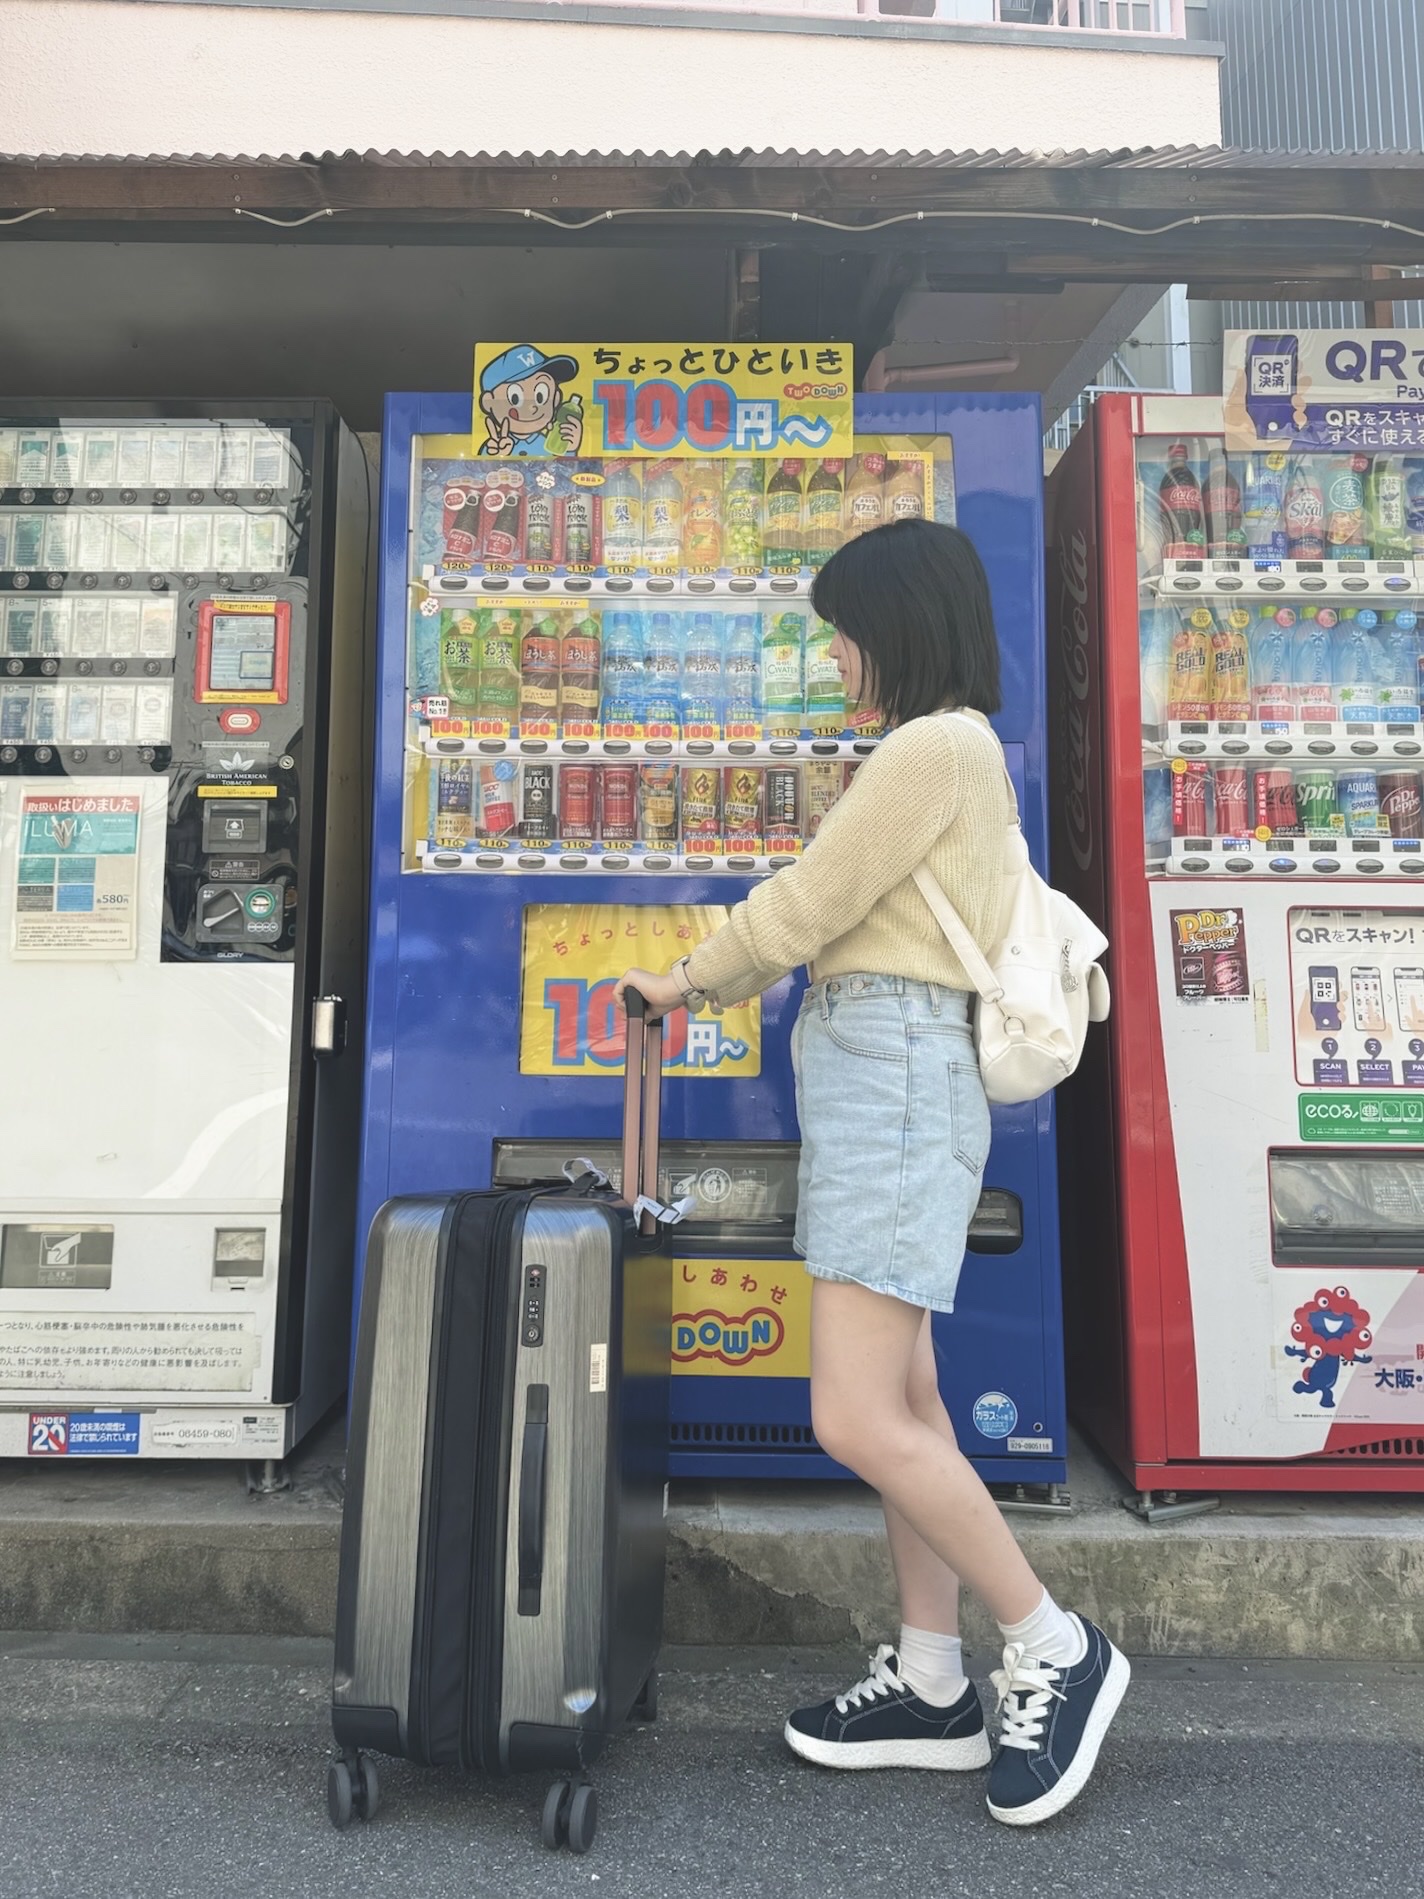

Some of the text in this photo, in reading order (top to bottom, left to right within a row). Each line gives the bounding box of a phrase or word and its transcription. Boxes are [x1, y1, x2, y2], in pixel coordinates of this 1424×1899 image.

[593, 347, 843, 376] ちょっとひといき
[1258, 361, 1284, 374] QR
[1258, 375, 1285, 388] 決済
[811, 383, 847, 398] DOWN
[1342, 479, 1358, 506] 麦茶
[615, 504, 630, 522] 梨
[654, 505, 669, 523] 梨
[526, 648, 556, 661] ほうじ茶
[567, 649, 598, 661] ほうじ茶
[1176, 646, 1205, 662] REAL
[1215, 647, 1246, 662] REAL
[1176, 656, 1206, 672] GOLD
[1215, 656, 1245, 673] GOLD
[1060, 529, 1092, 871] Coca-Cola
[206, 772, 267, 780] BRITISH AMERICAN
[524, 776, 551, 790] BLACK
[775, 776, 784, 807] BLACK
[27, 797, 135, 813] 取扱いはじめました
[685, 840, 721, 853] 100円
[725, 840, 761, 853] 100円
[766, 839, 801, 852] 100円
[1199, 910, 1226, 928] Dr
[1176, 914, 1238, 945] Pepper
[1295, 927, 1415, 944] QRをスキャン!
[1183, 941, 1235, 953] ドクターペッパー
[1319, 1062, 1342, 1070] SCAN
[1360, 1063, 1389, 1071] SELECT
[683, 1264, 788, 1305] しあわせ
[677, 1319, 771, 1355] DOWN
[32, 1416, 66, 1425] UNDER
[32, 1423, 66, 1451] 20
